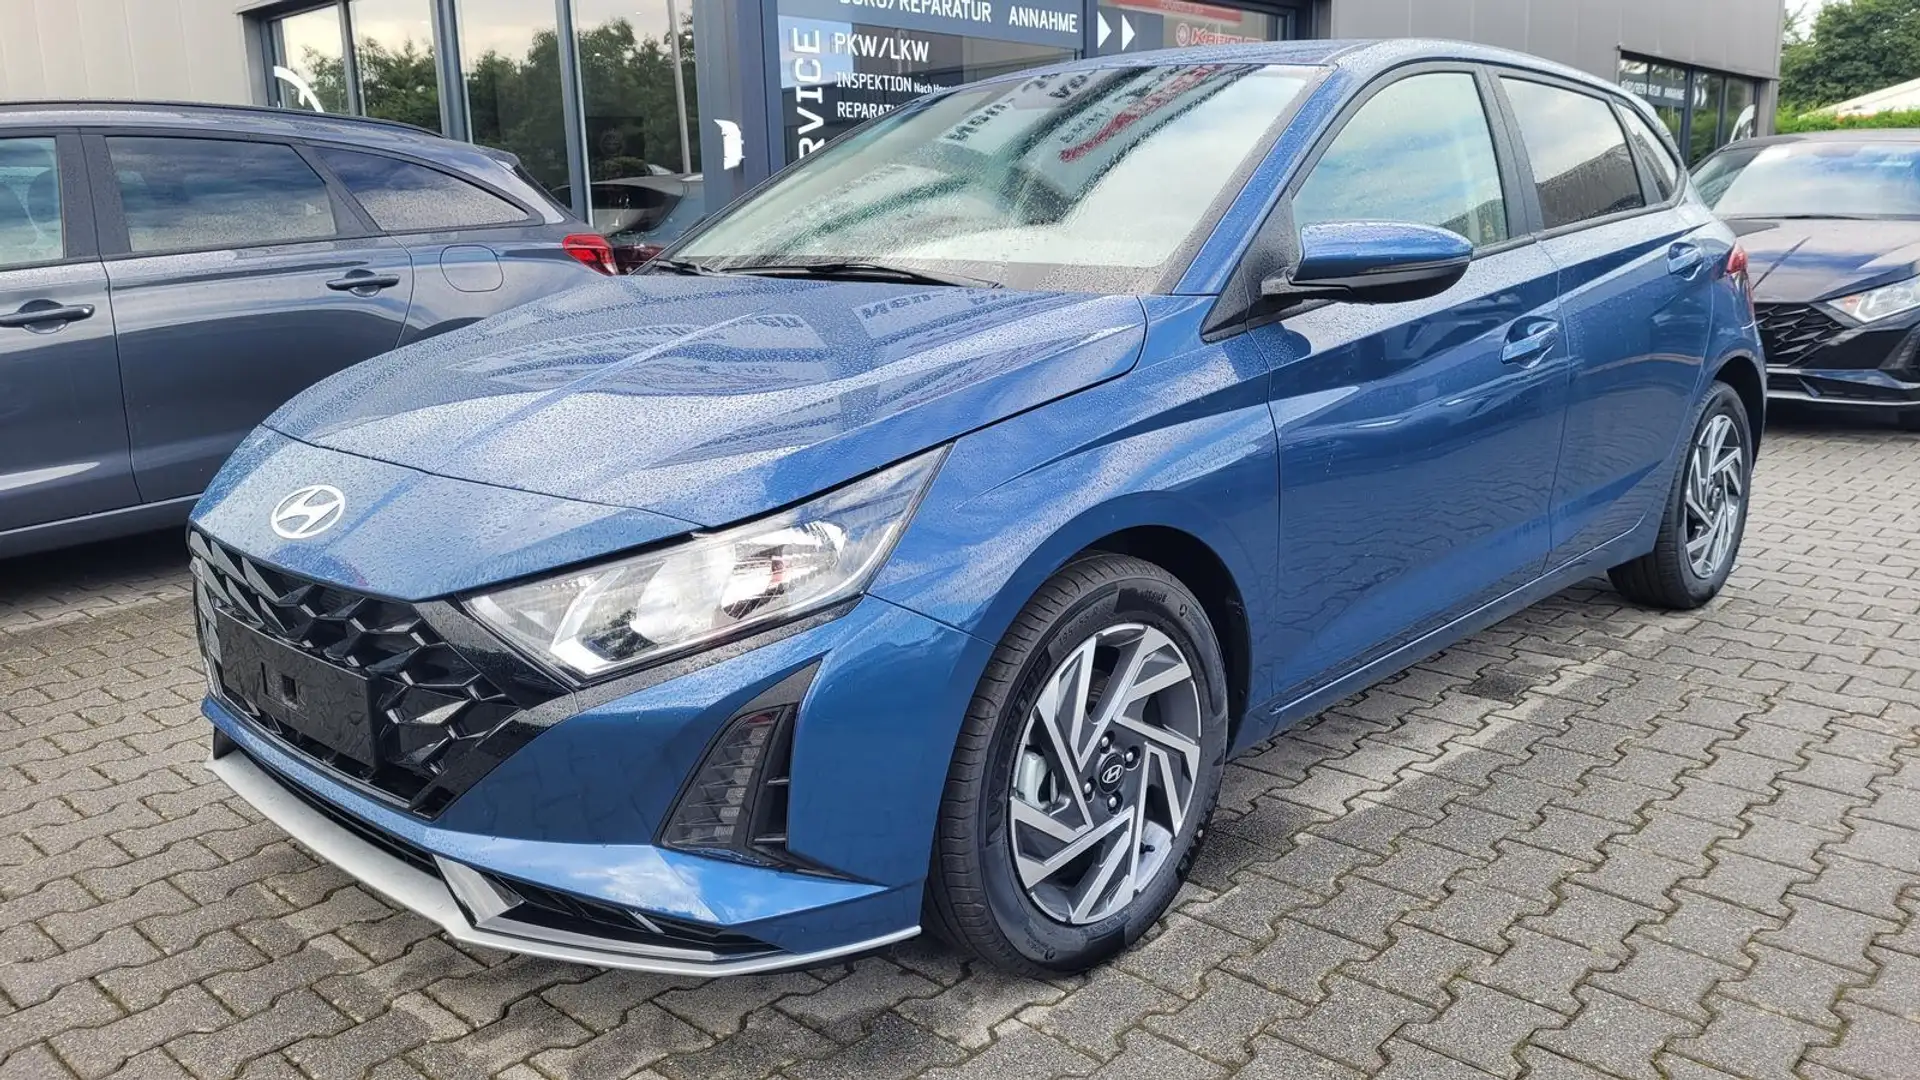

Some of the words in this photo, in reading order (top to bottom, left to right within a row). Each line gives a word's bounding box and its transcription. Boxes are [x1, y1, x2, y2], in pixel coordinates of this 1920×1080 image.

[839, 0, 992, 23] /REPARATUR
[1008, 6, 1078, 33] ANNAHME
[834, 32, 929, 62] PKW/LKW
[836, 71, 912, 93] INSPEKTION
[914, 81, 933, 94] Nach
[836, 101, 895, 118] REPARAT
